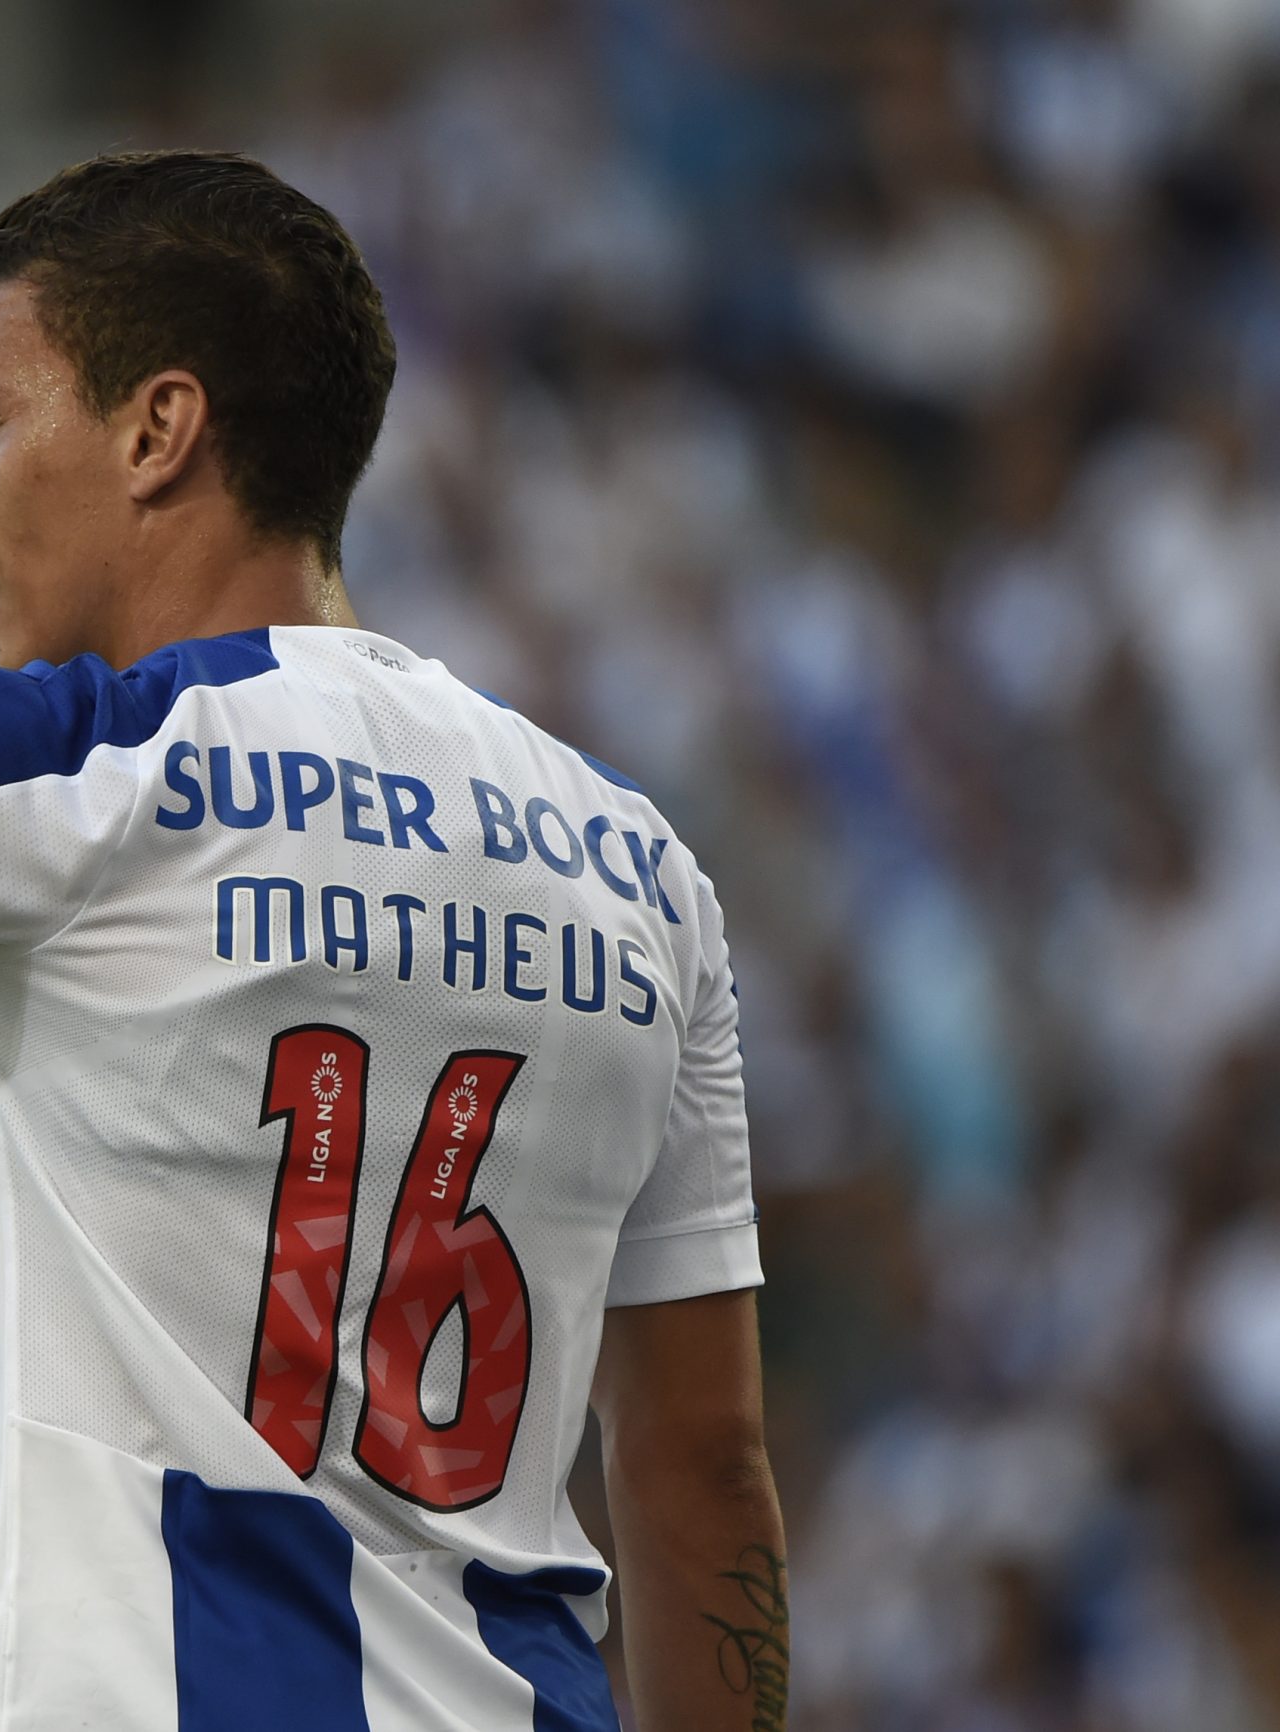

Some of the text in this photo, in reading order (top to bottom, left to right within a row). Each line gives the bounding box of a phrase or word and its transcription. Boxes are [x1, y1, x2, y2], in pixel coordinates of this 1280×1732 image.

[368, 647, 411, 674] Porto
[156, 740, 682, 925] SUPER BOCK
[212, 872, 660, 1028] MATHEUS
[307, 1052, 343, 1183] LIGA NOS
[430, 1072, 478, 1200] LIGA NOS
[244, 1023, 533, 1514] 16
